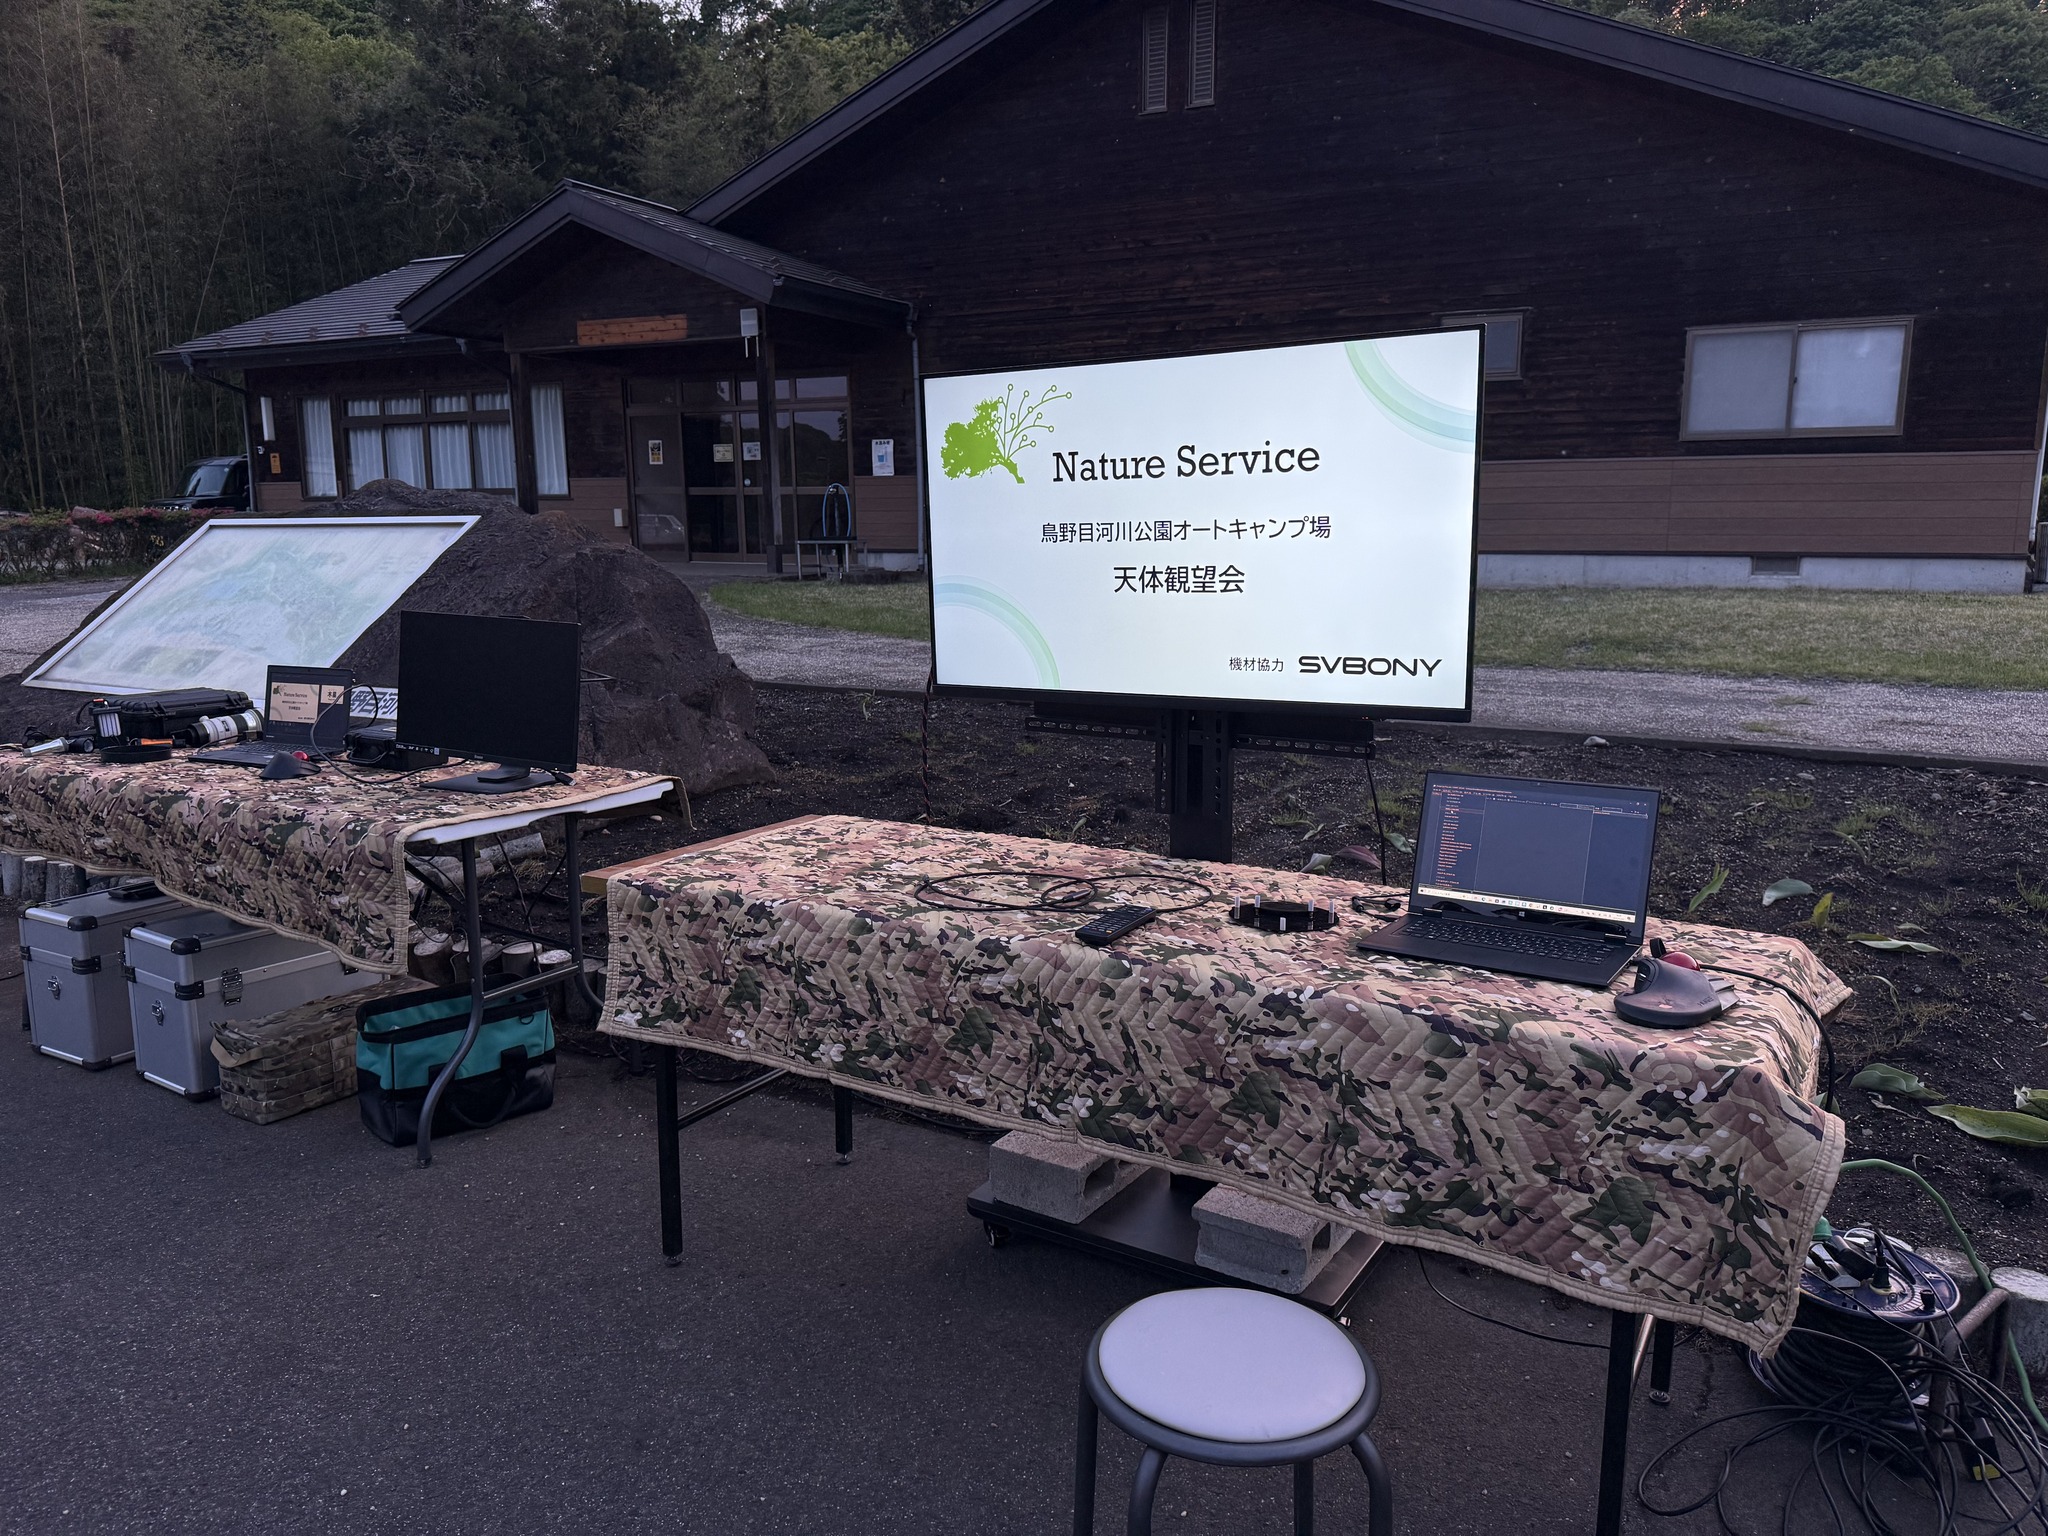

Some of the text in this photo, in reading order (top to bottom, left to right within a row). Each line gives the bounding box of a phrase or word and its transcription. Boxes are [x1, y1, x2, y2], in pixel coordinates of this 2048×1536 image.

[1052, 440, 1320, 483] Nature Service
[1041, 515, 1332, 544] 鳥野目河川公園オートキャンプ場
[1113, 564, 1246, 594] 天体観望会
[1228, 656, 1285, 673] 機材協力
[1298, 655, 1443, 678] SVBONY
